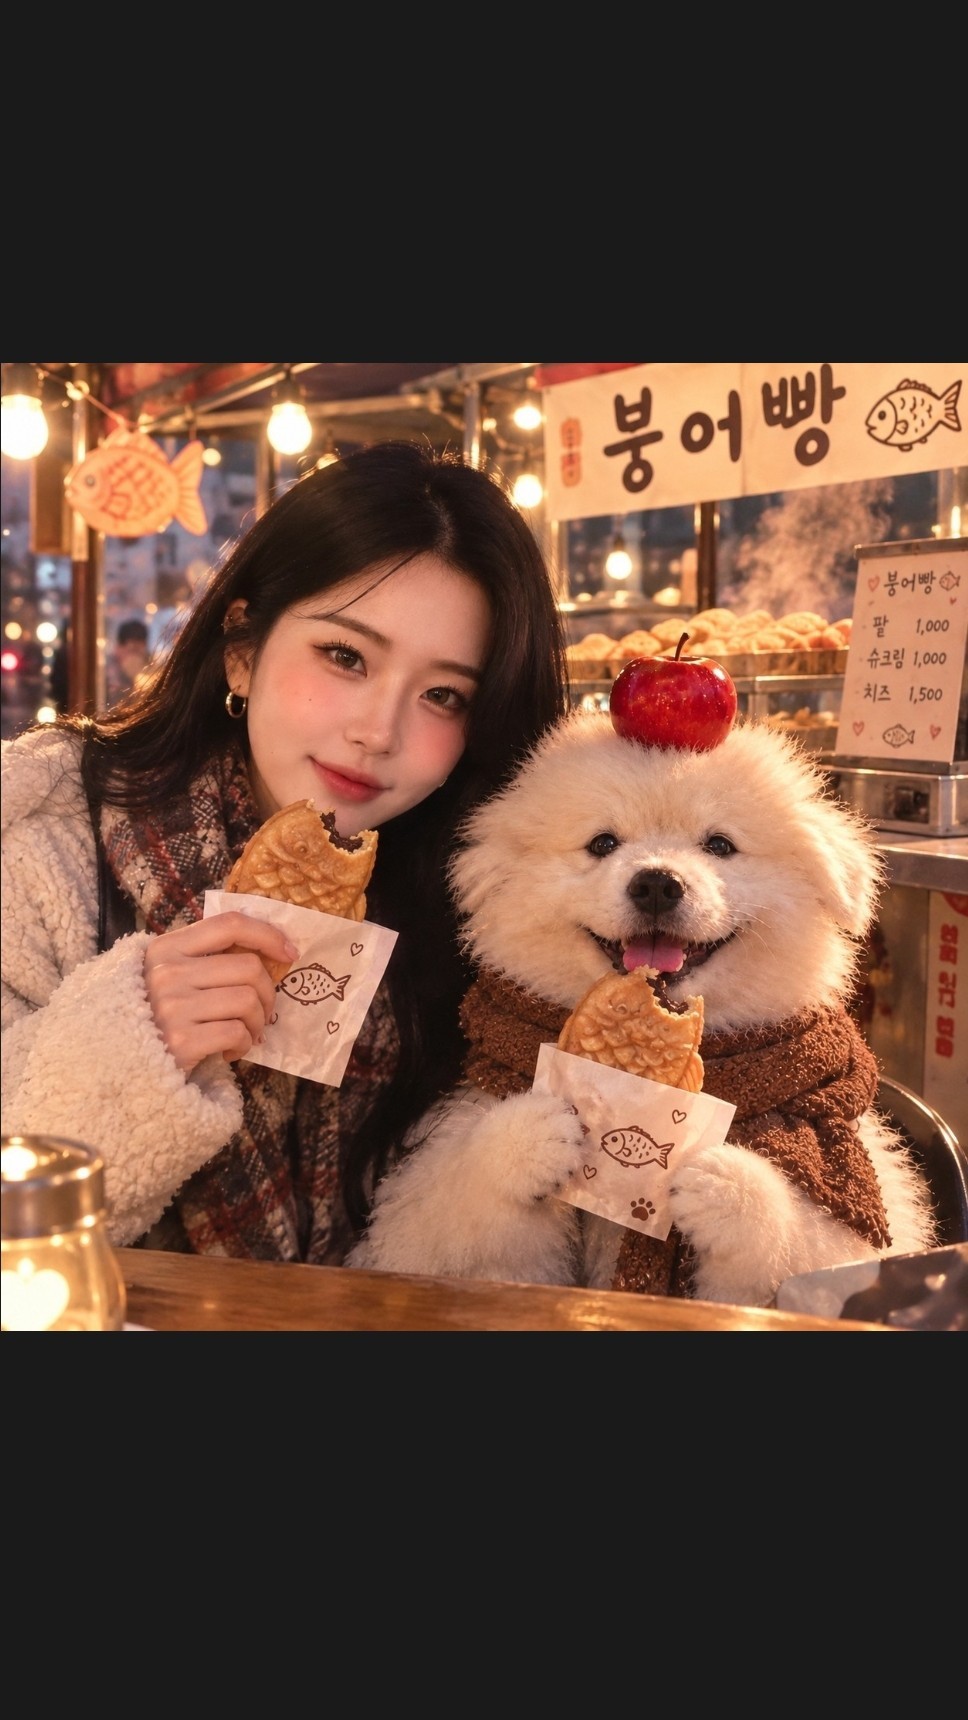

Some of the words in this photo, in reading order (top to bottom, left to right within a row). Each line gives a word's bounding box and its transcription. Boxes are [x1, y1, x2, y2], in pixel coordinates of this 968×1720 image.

[603, 363, 846, 494] 붕어빵
[883, 570, 937, 597] 붕어빵
[872, 614, 889, 638] 팔
[915, 618, 950, 635] 1,000
[866, 647, 905, 669] 슈크림
[913, 651, 947, 668] 1,000
[863, 682, 892, 703] 치즈
[908, 686, 943, 704] 1,500
